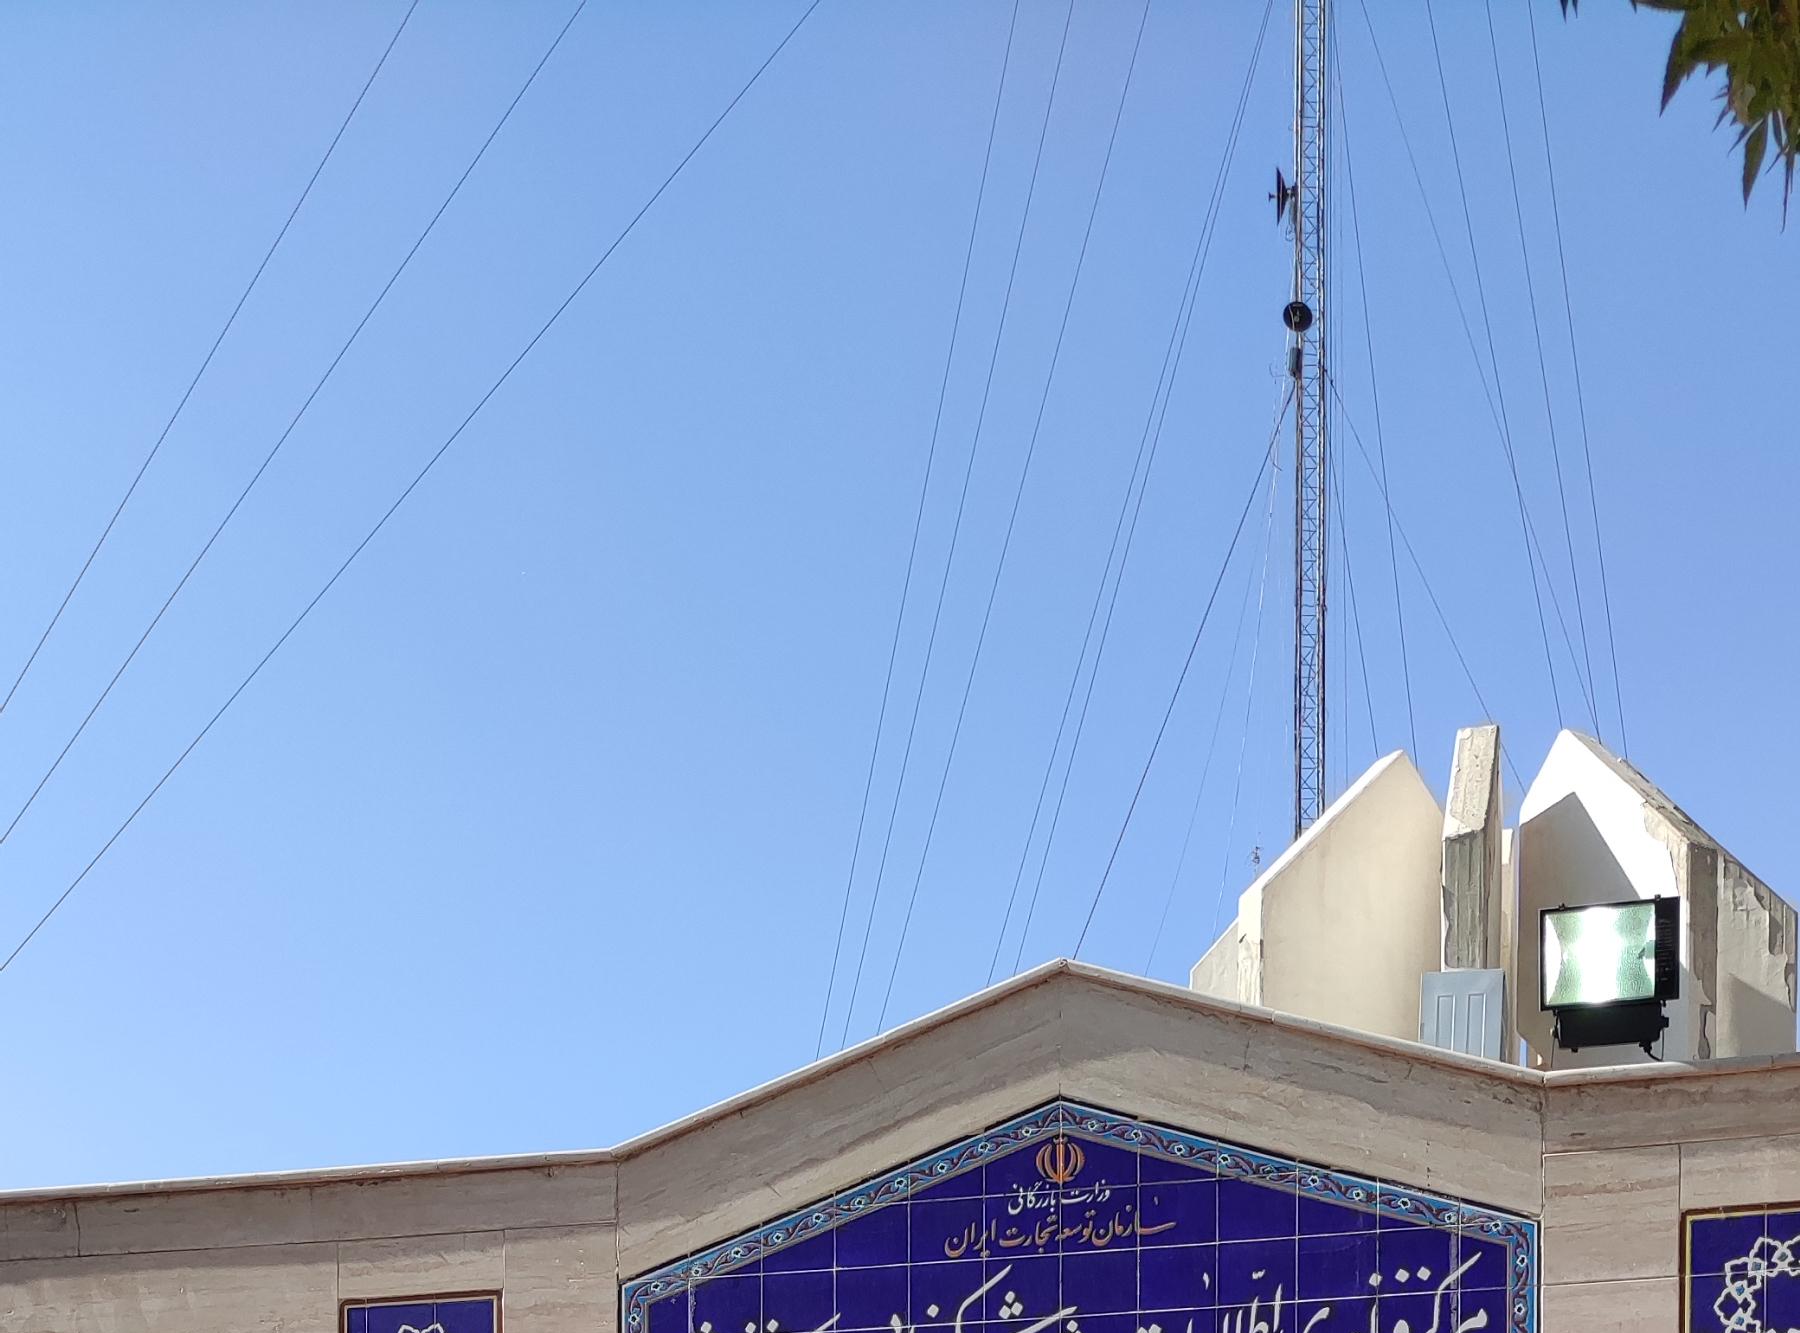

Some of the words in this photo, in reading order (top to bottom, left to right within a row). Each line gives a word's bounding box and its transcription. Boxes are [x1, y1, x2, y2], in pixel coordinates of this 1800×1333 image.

[1008, 1180, 1058, 1216] بازرگانی
[1062, 1178, 1111, 1205] وزارت
[944, 1217, 998, 1258] ایران
[999, 1214, 1059, 1253] تجارت
[1054, 1209, 1097, 1244] توسعه
[1092, 1195, 1177, 1247] سازمان
